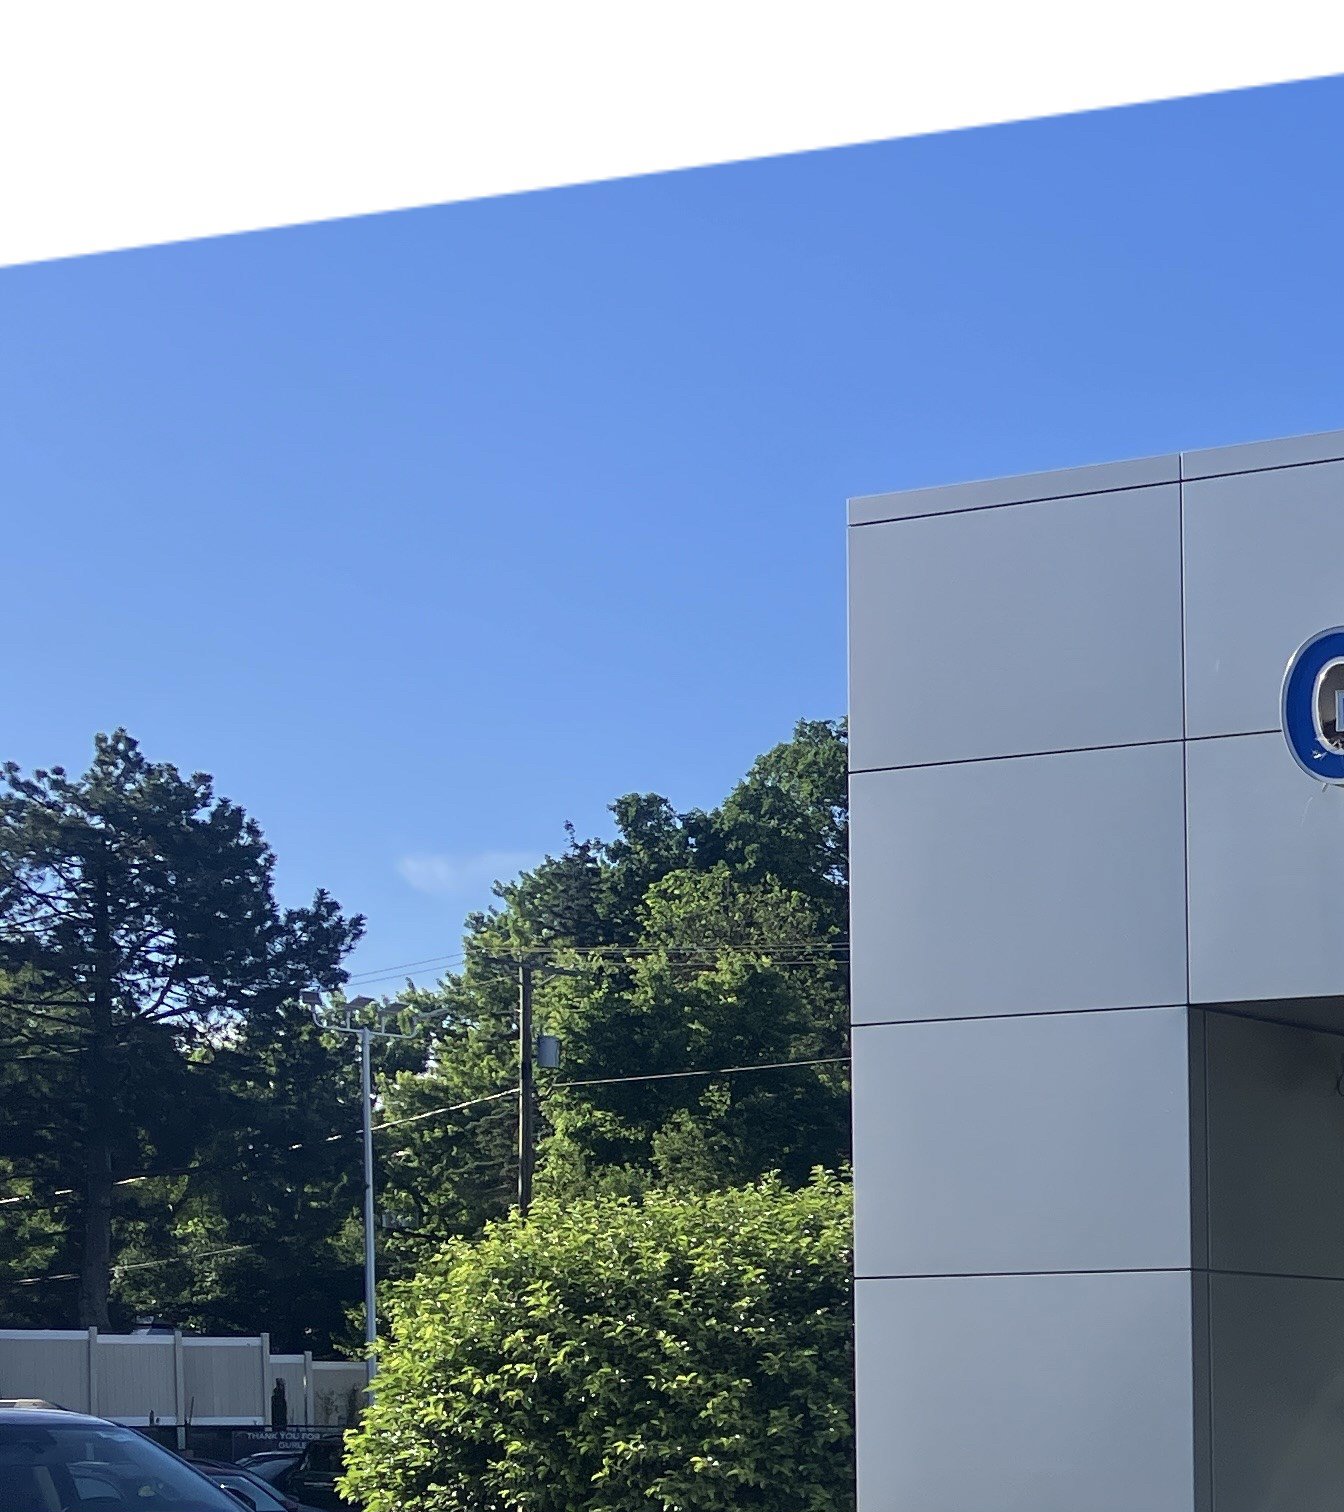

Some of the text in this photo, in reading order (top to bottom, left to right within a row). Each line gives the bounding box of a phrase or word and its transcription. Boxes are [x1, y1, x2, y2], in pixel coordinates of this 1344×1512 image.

[247, 1431, 321, 1441] THANK YOU FOR
[278, 1441, 308, 1450] GURLE
